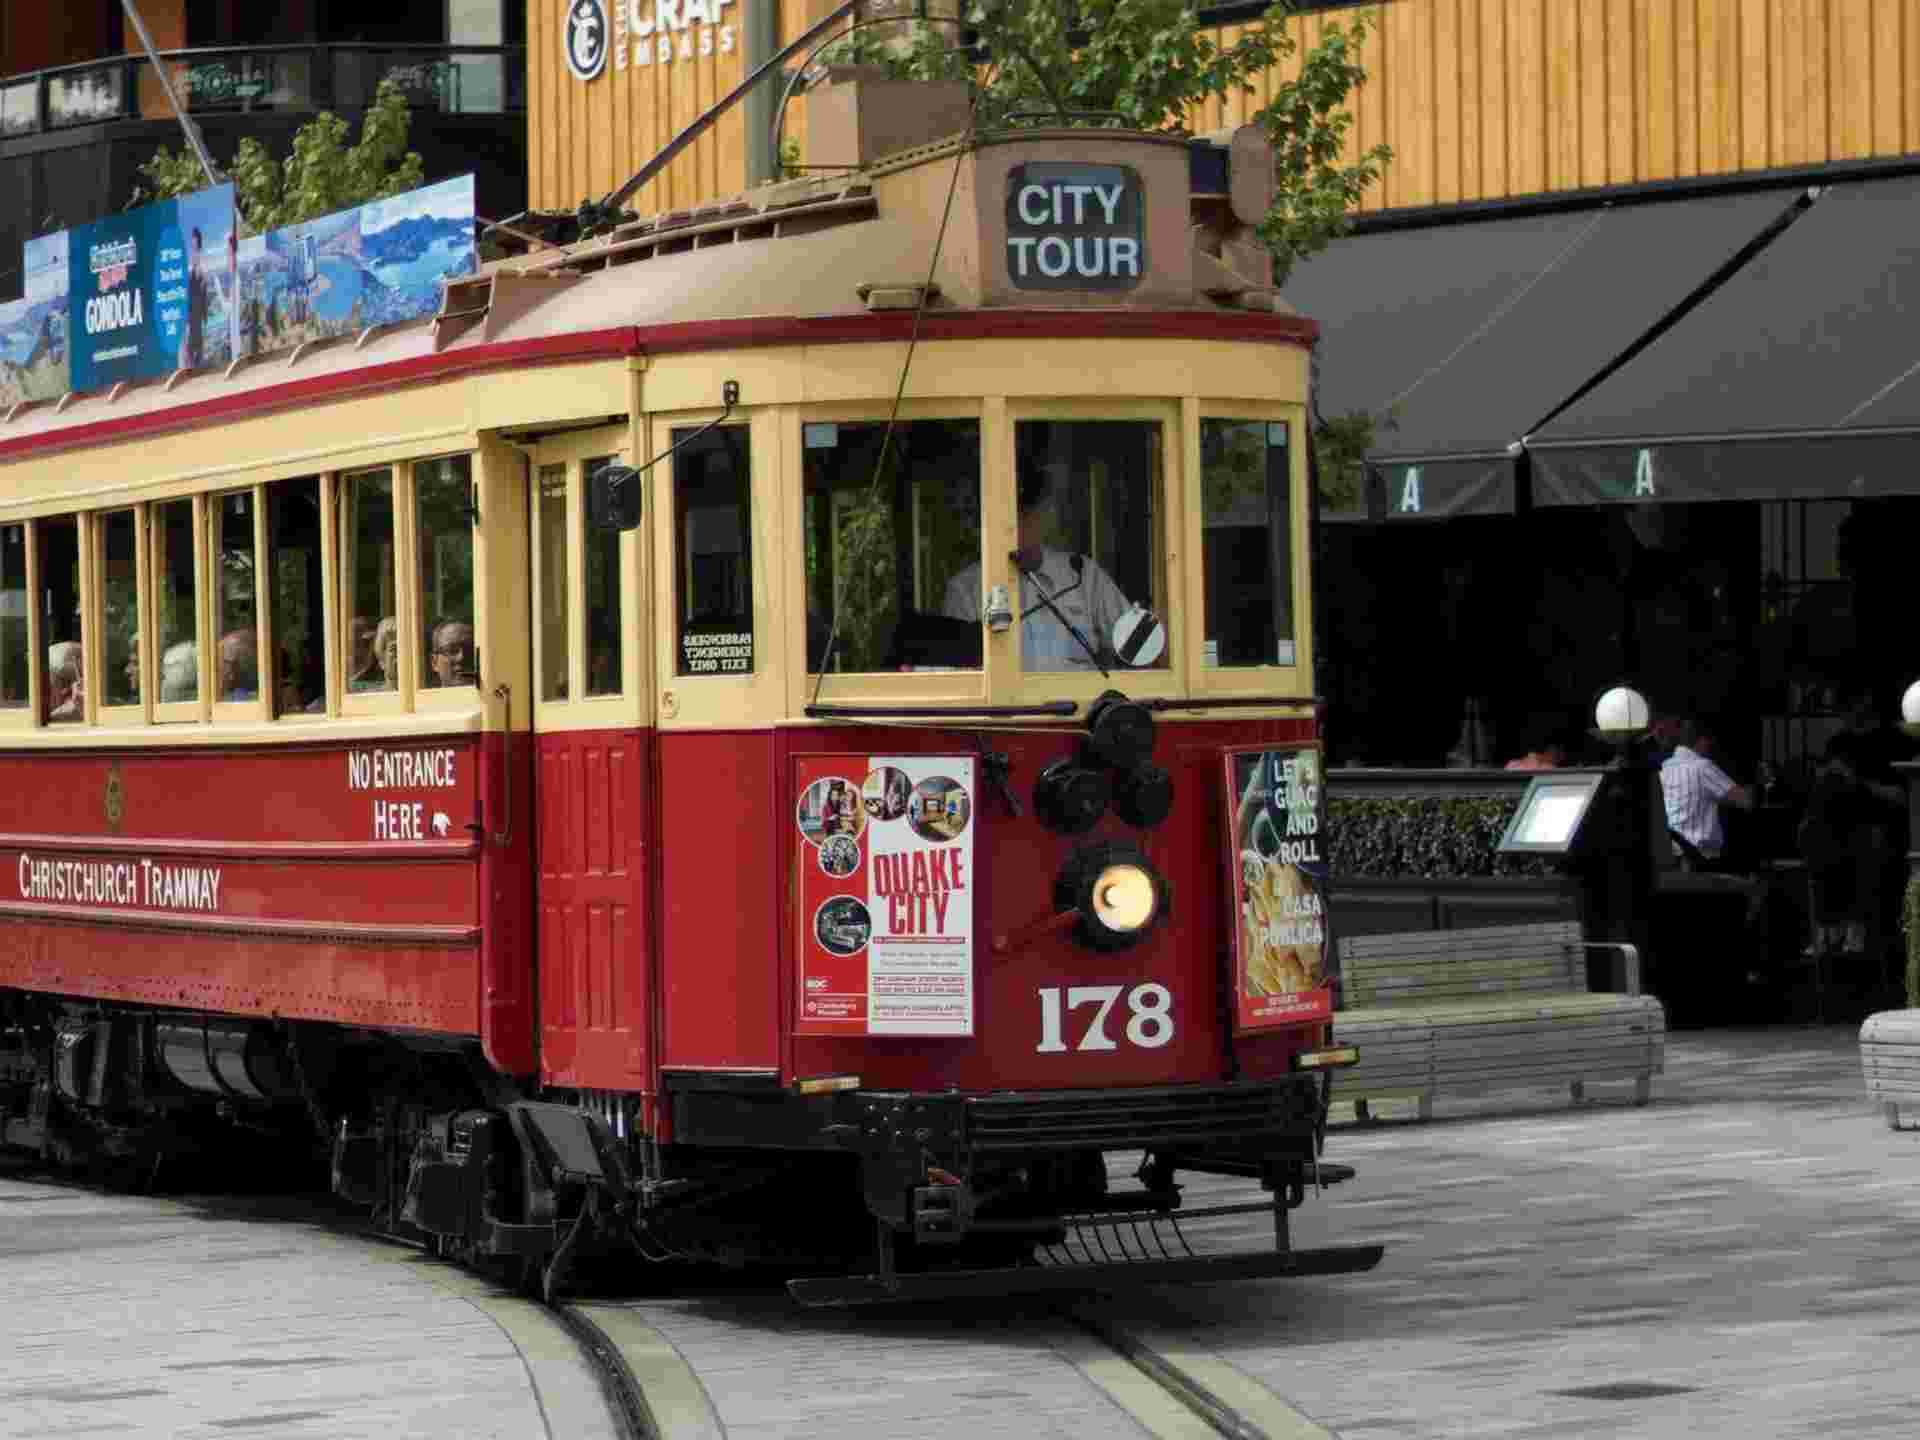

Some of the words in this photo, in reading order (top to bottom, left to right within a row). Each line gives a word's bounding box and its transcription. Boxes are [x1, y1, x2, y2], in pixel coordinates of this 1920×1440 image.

[1017, 184, 1124, 225] CITY
[1007, 236, 1139, 277] TOUR
[85, 288, 144, 335] GONDOLA
[1400, 465, 1422, 514] A
[1634, 447, 1656, 497] A
[348, 750, 370, 790] NO
[373, 749, 456, 788] ENTRANCE
[375, 799, 425, 840] HERE
[1286, 813, 1317, 836] AND
[873, 847, 965, 899] QUAKE
[1280, 840, 1320, 864] ROLL
[18, 852, 138, 905] CHRISTCHURCH
[140, 858, 221, 910] TRAMWAY
[888, 891, 950, 935] CITY
[1036, 982, 1175, 1053] 178
